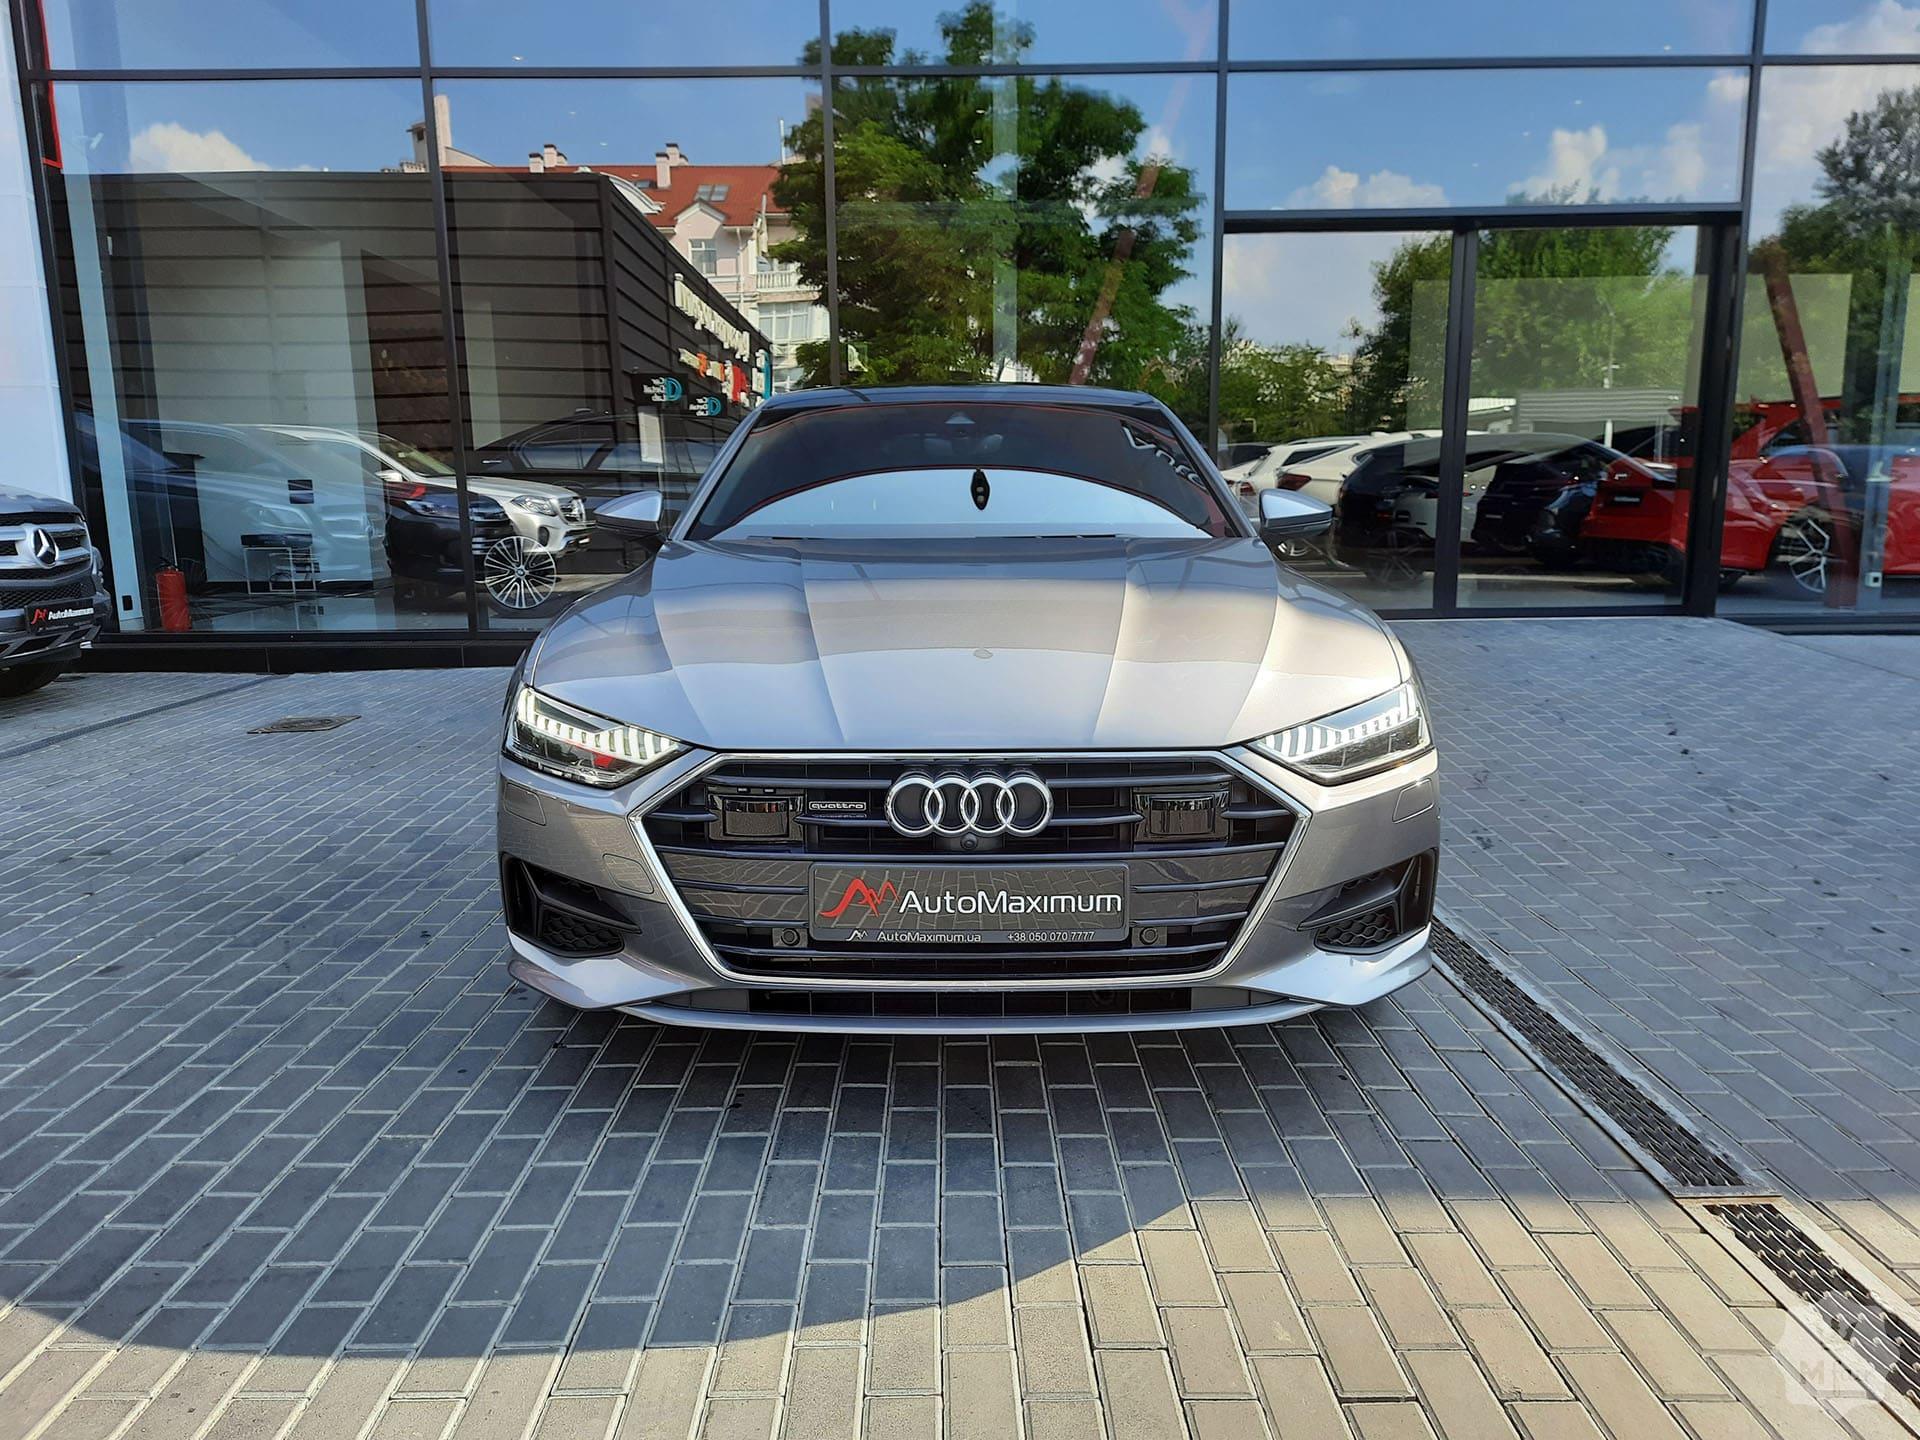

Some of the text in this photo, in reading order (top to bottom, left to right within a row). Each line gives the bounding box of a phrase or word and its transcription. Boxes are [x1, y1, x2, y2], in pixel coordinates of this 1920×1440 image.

[811, 802, 864, 811] quattro
[899, 890, 1122, 914] AutoMaximum
[877, 931, 982, 942] AutoMaximum.ua
[1007, 931, 1095, 942] +38 050 070 7777
